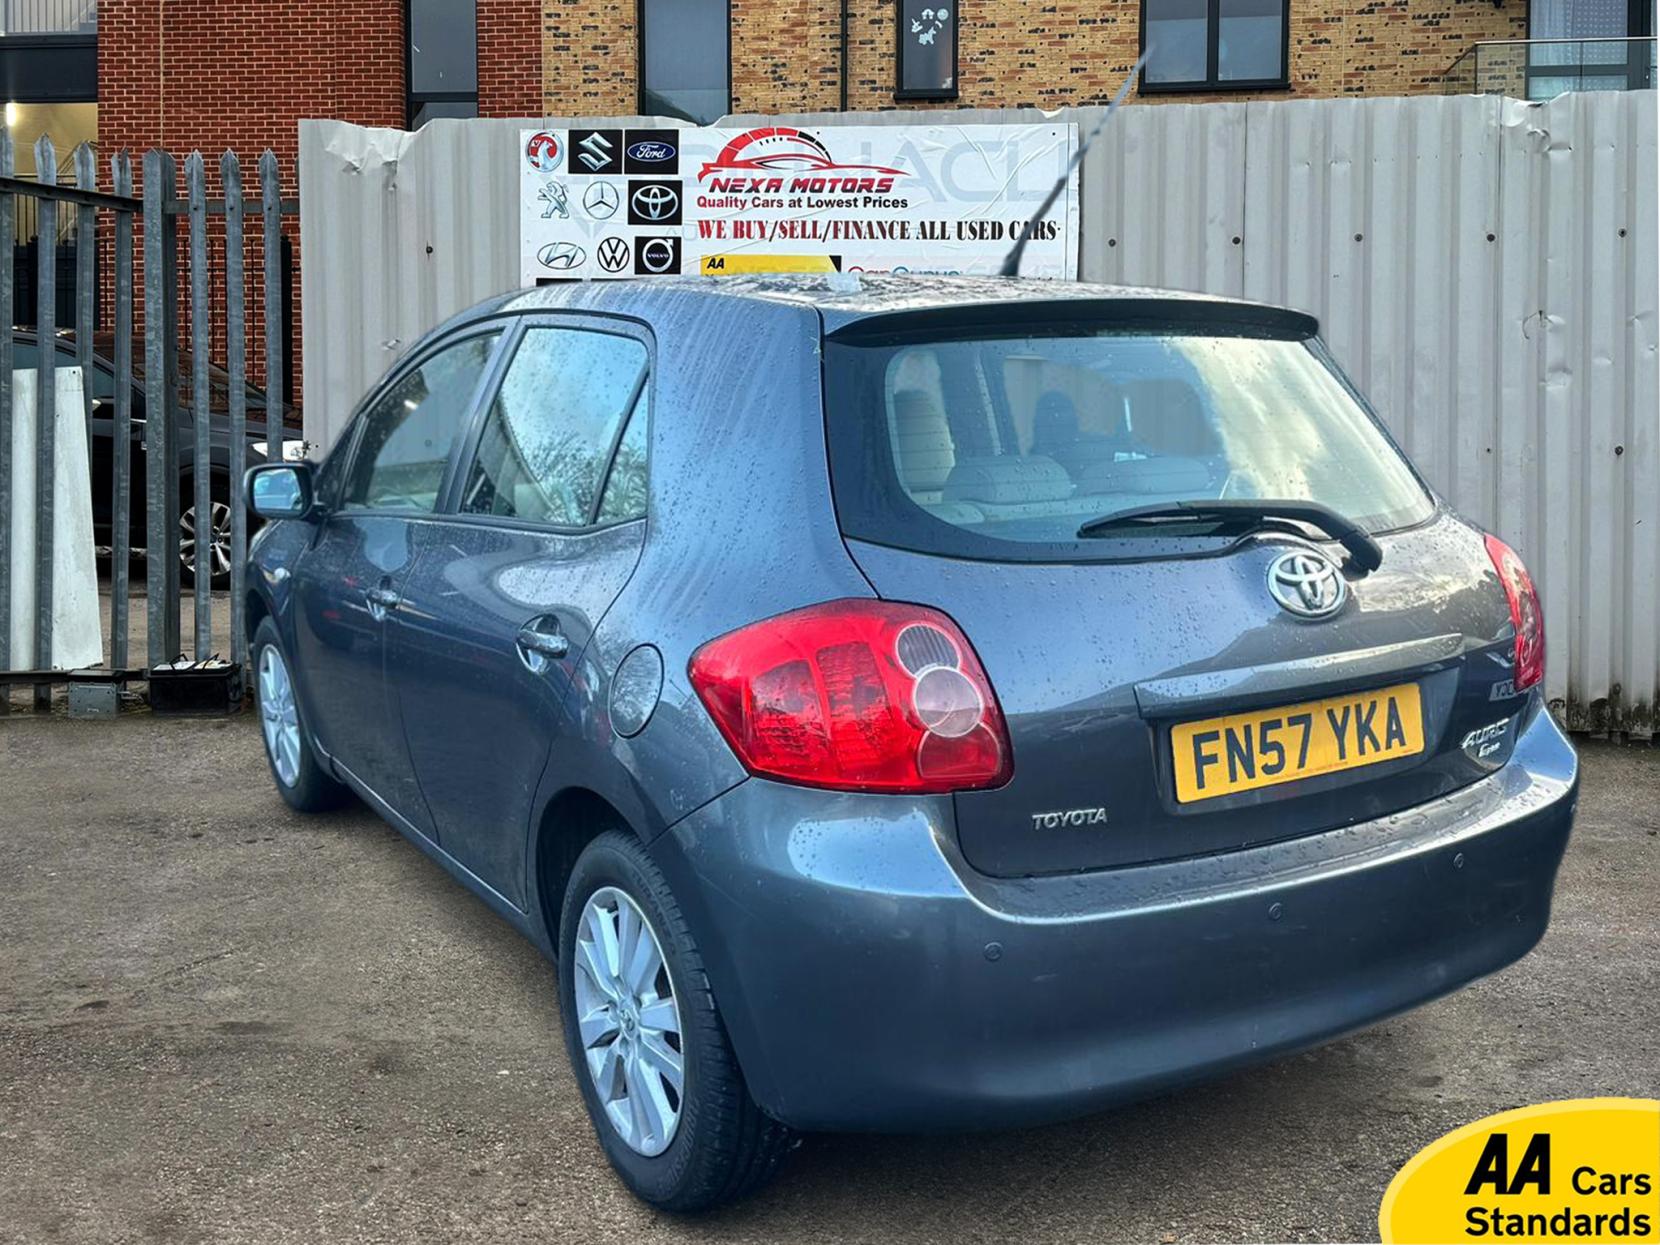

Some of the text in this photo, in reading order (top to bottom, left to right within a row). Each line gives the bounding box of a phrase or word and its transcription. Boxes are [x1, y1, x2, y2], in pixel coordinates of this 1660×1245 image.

[636, 144, 666, 158] Ford
[709, 178, 894, 193] NEXA MOTORS
[697, 196, 908, 210] Quality Cars at Lowest Prices
[698, 220, 726, 239] WE
[733, 220, 910, 242] BUY/SELL/FINANCE
[916, 220, 951, 240] ALL
[957, 220, 1004, 240] USED
[706, 257, 724, 269] AA
[1192, 696, 1407, 790] FN57 YKA
[1032, 807, 1107, 830] TOYOTA
